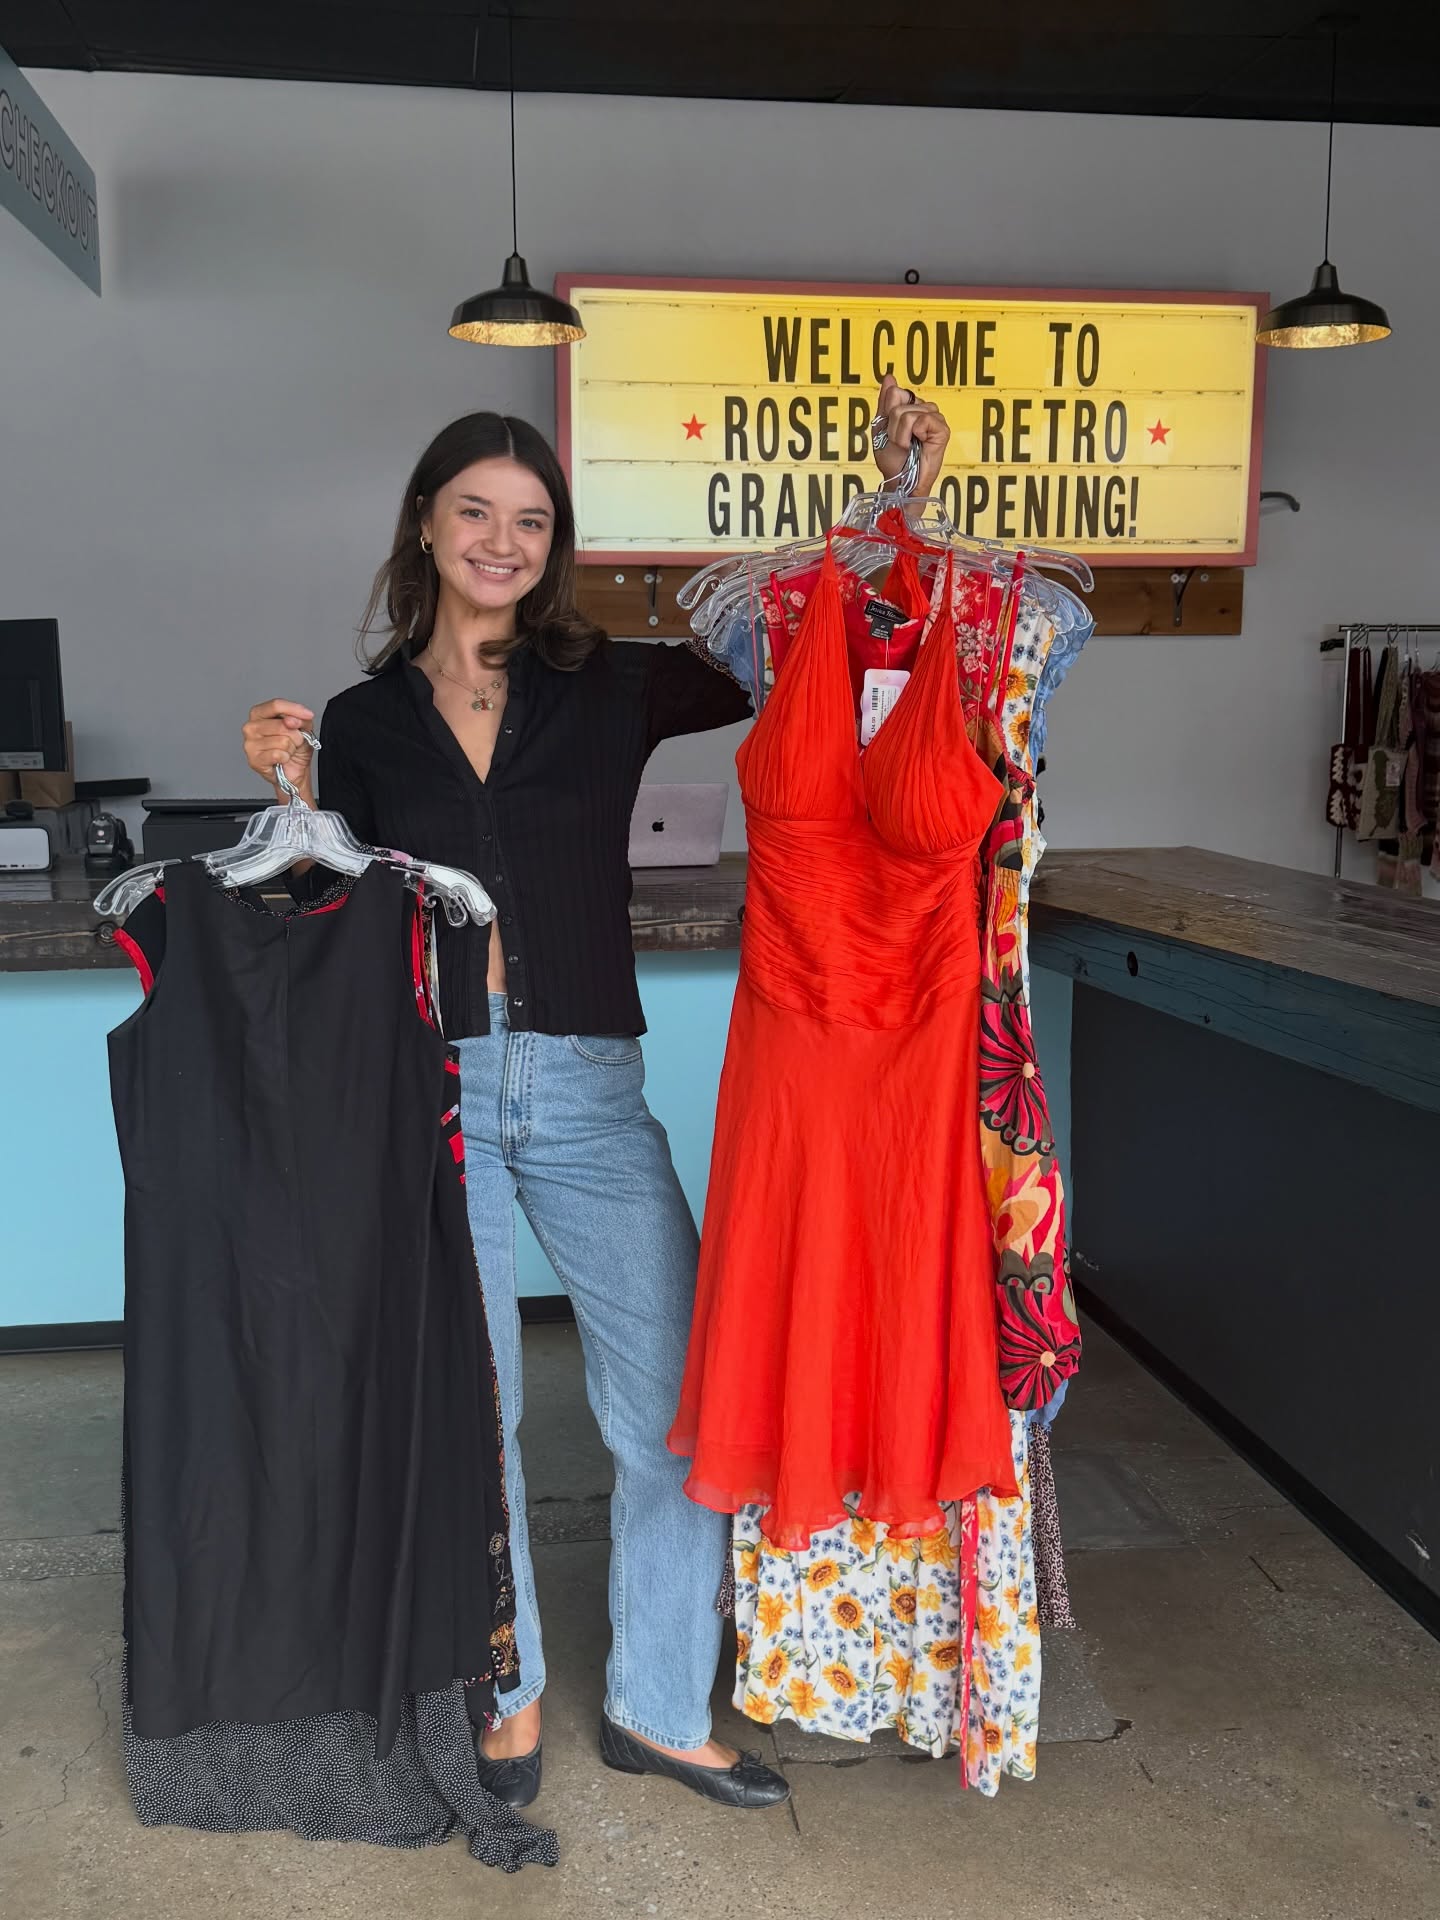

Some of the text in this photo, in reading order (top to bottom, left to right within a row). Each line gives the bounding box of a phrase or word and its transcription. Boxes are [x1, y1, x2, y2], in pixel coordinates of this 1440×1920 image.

[0, 89, 97, 260] CHECKOUT
[763, 316, 1101, 387] WELCOME TO
[725, 396, 1128, 463] ROSEB RETRO
[939, 475, 1139, 538] OPENING!
